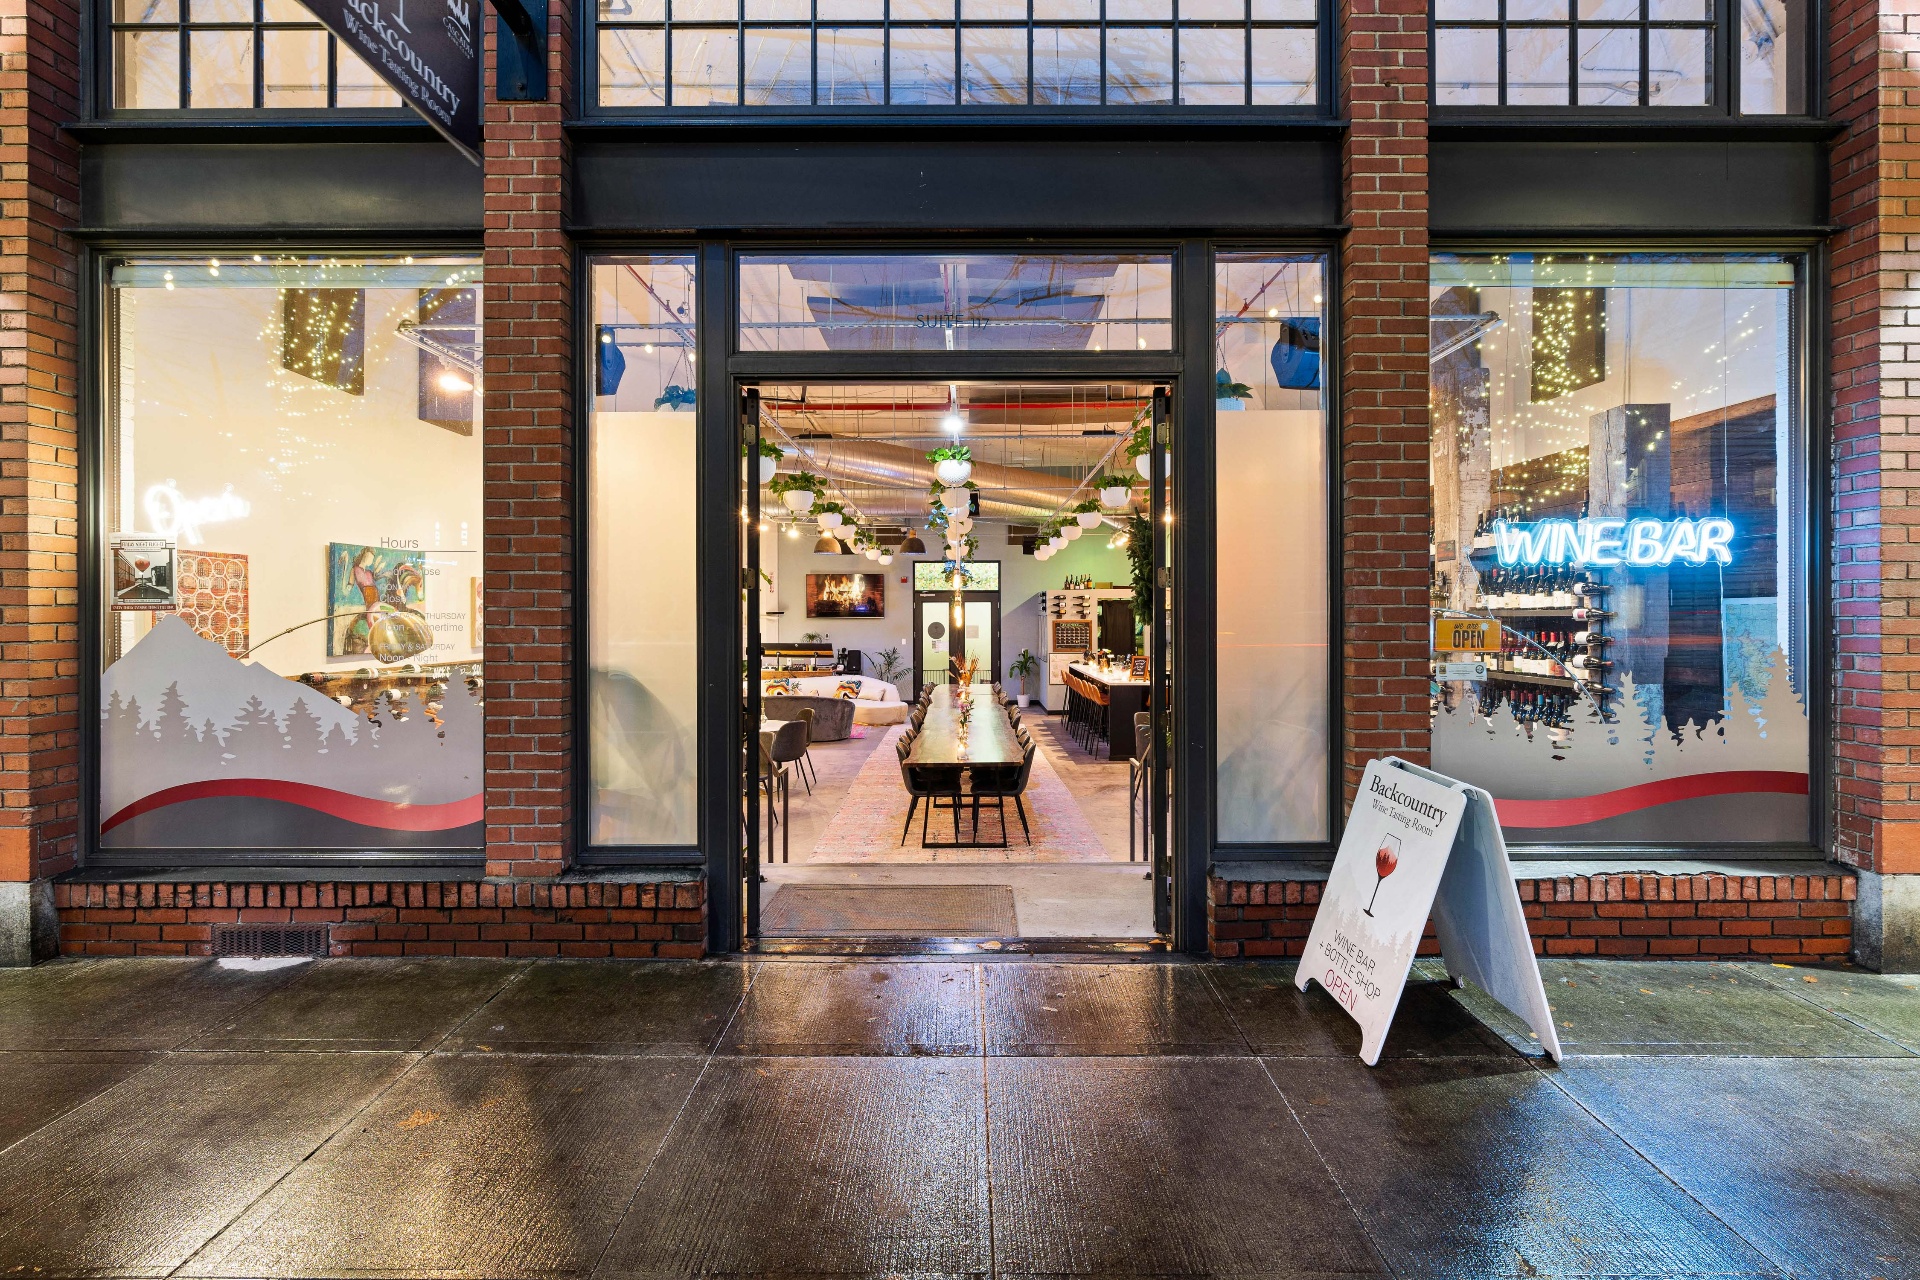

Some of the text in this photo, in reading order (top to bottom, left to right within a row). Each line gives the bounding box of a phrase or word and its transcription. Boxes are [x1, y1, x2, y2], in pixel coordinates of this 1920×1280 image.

[343, 8, 378, 54] Wine
[379, 44, 419, 98] Tasting
[421, 86, 452, 126] Room
[347, 0, 460, 116] ackcountry
[916, 314, 990, 331] SUITE 117
[380, 537, 419, 549] Hours
[1496, 519, 1733, 565] WINE BAR
[426, 612, 466, 620] THURSDAY
[379, 653, 405, 662] Noon
[413, 653, 438, 664] Night
[1452, 630, 1485, 648] OPEN
[1369, 774, 1448, 828] Backcountry
[1372, 798, 1434, 837] Wine Tasting Room
[1324, 942, 1356, 979] BOTTLE
[1354, 970, 1381, 1000] SHOP
[1334, 929, 1376, 975] WINE BAR
[1324, 969, 1358, 1012] OPEN
